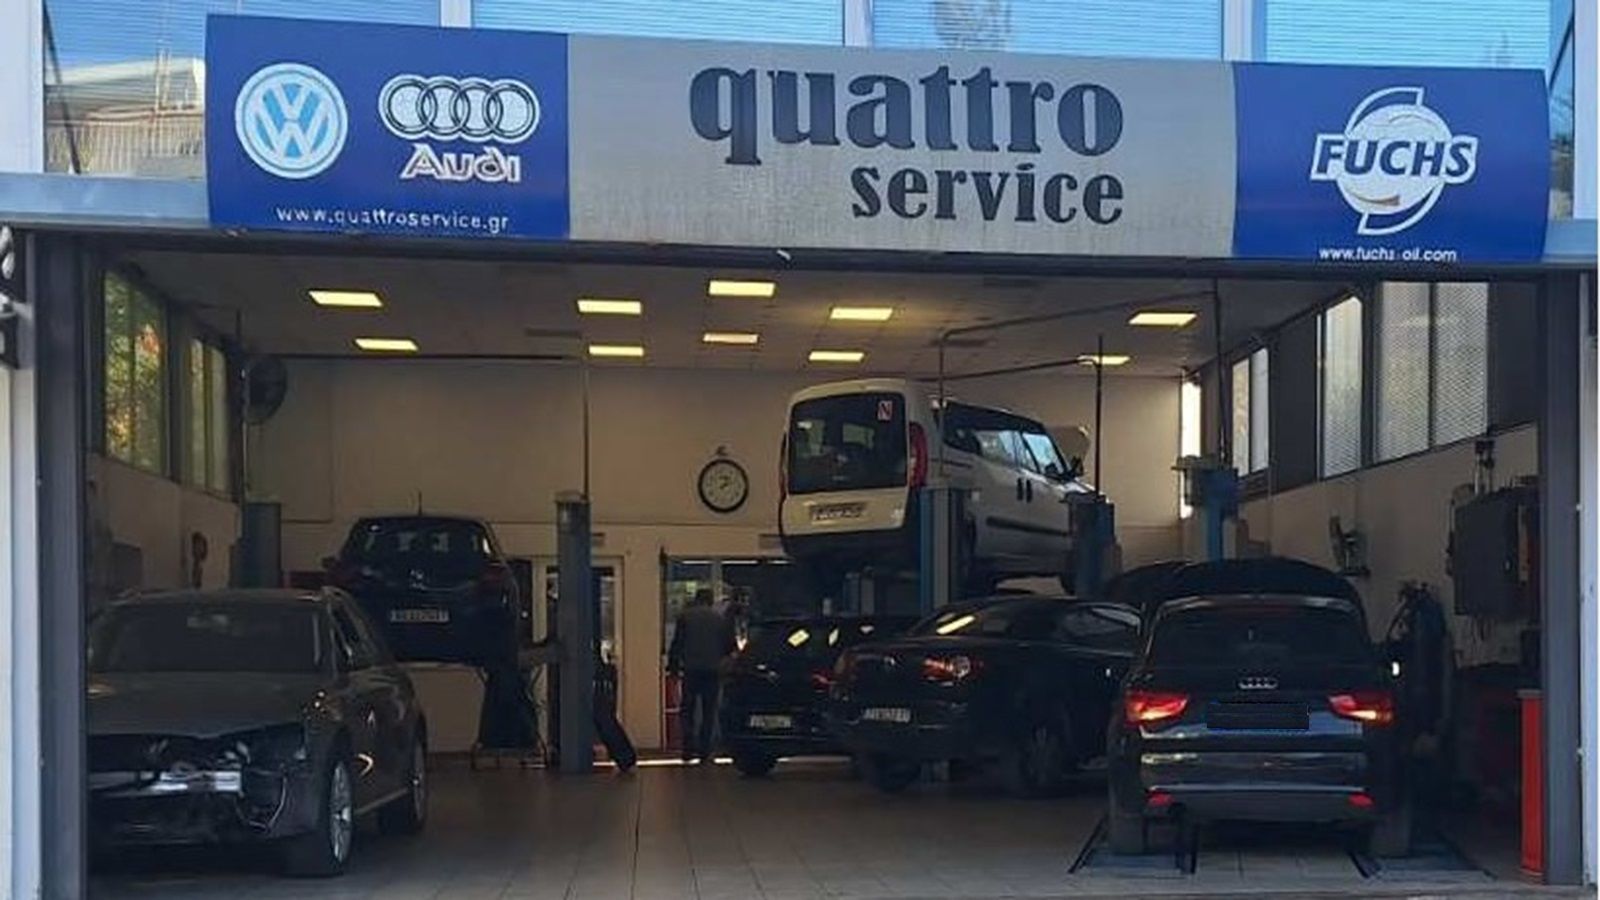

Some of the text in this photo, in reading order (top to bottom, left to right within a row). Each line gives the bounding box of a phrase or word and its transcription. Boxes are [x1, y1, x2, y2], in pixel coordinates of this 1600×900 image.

[689, 65, 1124, 165] quattro
[400, 143, 521, 182] Audi
[1316, 139, 1472, 177] FUCHS
[850, 163, 1124, 225] service
[276, 207, 509, 234] www.quattroservice.gr
[1319, 247, 1457, 261] www.fuchsoil.com
